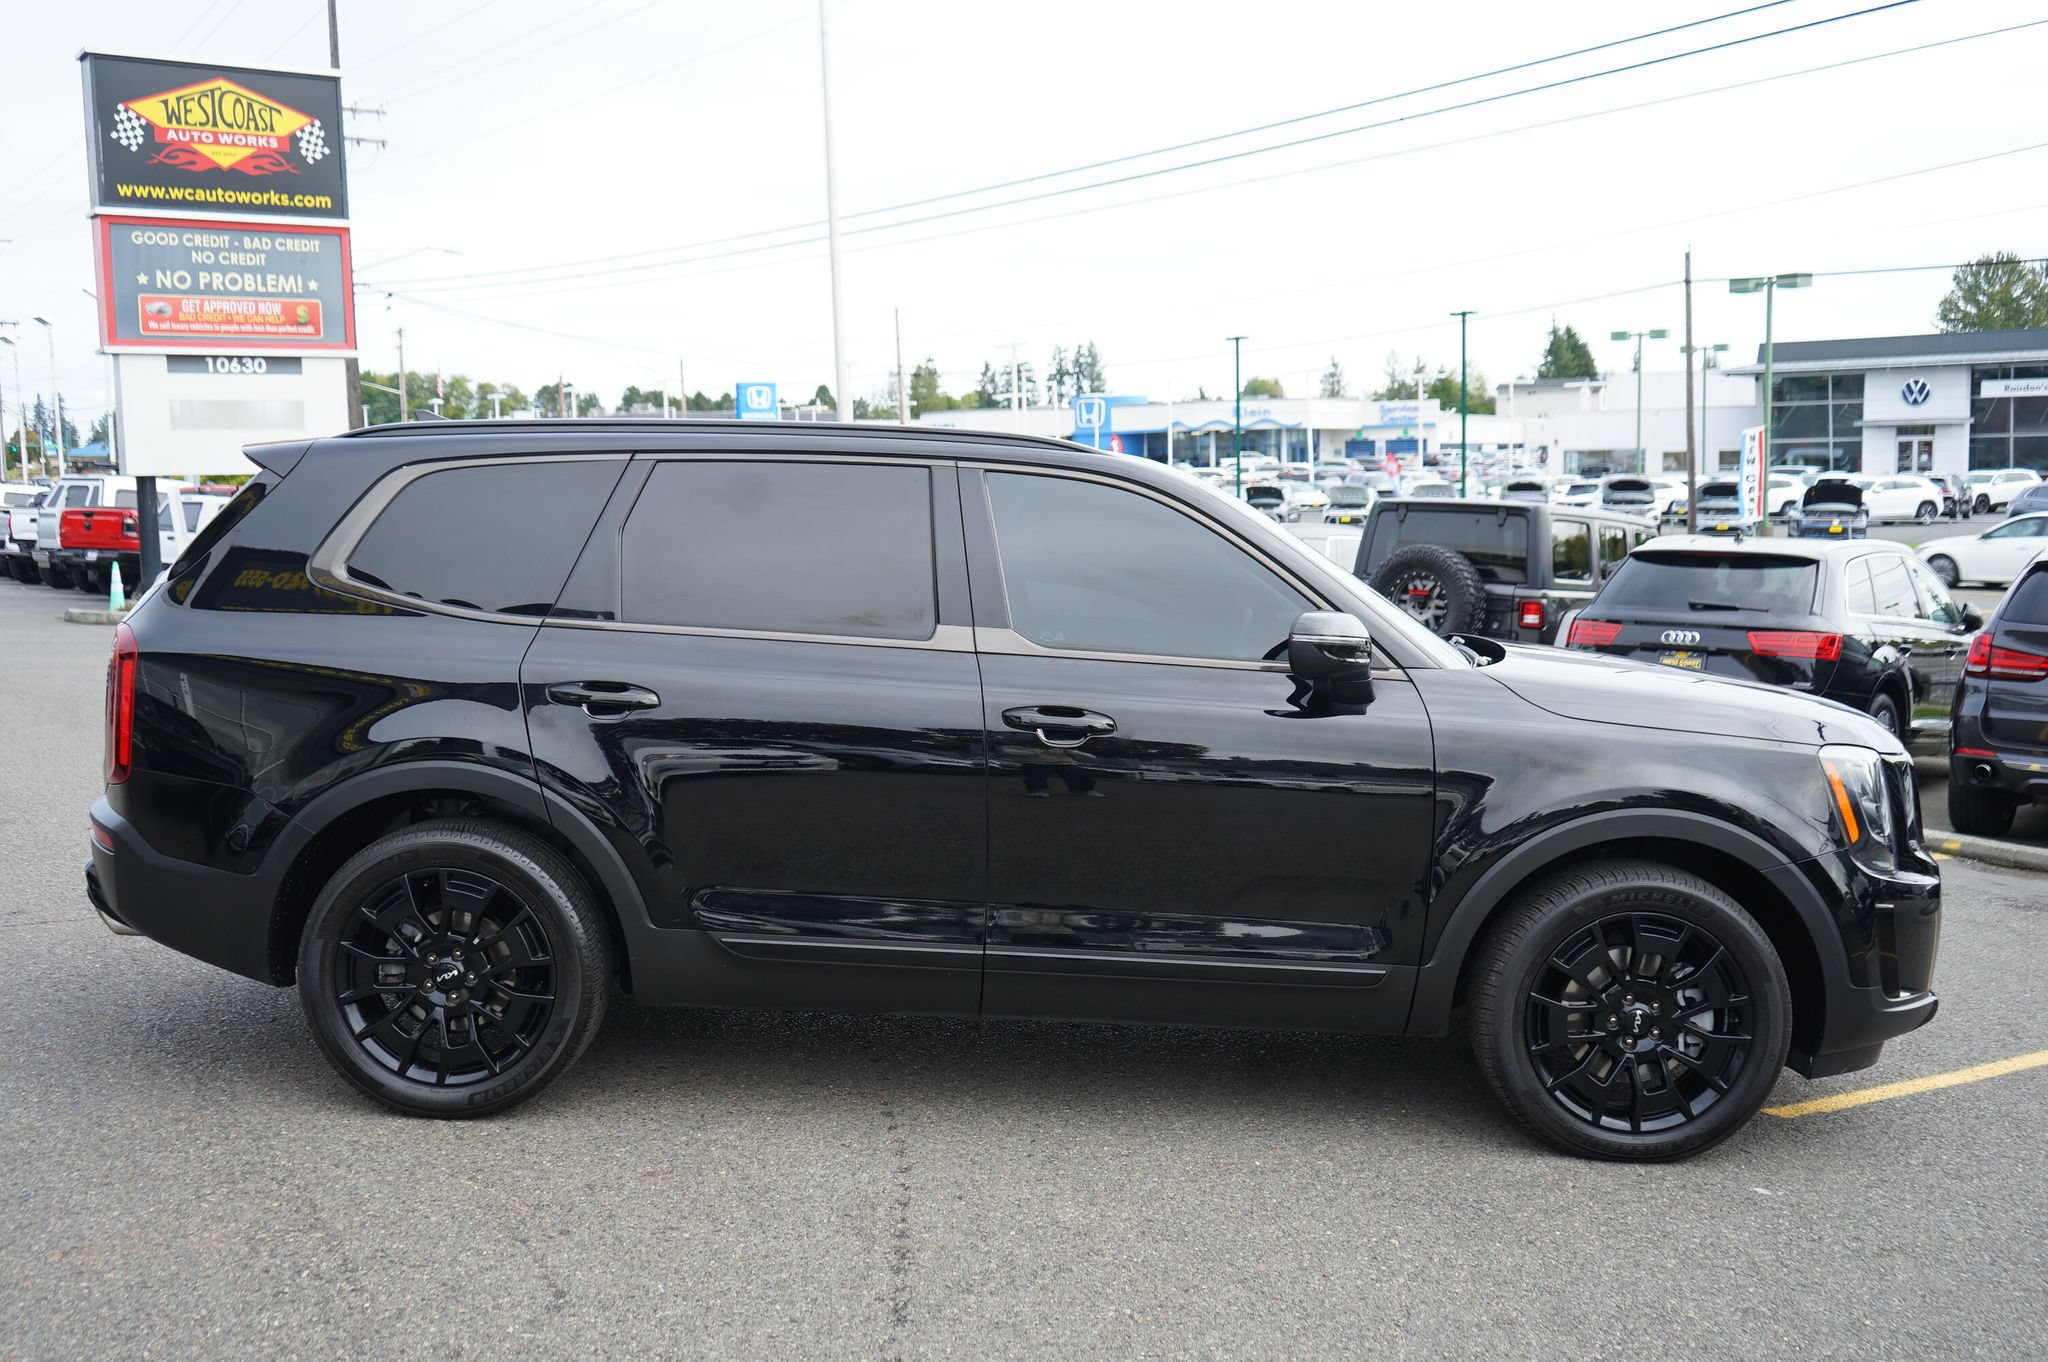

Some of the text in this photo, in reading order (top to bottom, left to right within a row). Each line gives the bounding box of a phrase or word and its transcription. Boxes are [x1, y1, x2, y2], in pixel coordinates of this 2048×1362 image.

[160, 87, 282, 133] WESTCOAST
[166, 129, 278, 149] AUTO WORKS
[117, 183, 332, 209] www.wcautoworks.com
[131, 230, 179, 246] GOOD
[183, 233, 230, 248] CREDIT
[243, 236, 272, 250] BAD
[275, 237, 320, 252] CREDIT
[191, 249, 266, 266] NO CREDIT
[155, 269, 303, 294] NO PROBLEM!
[182, 299, 281, 315] GET APPROVED NOW
[148, 320, 159, 329] We
[159, 320, 171, 329] sell
[171, 321, 189, 331] luxury
[179, 312, 196, 320] BAD
[197, 313, 225, 322] CREDIT
[232, 314, 246, 323] WE
[247, 314, 264, 323] CAN
[205, 356, 267, 375] 10630
